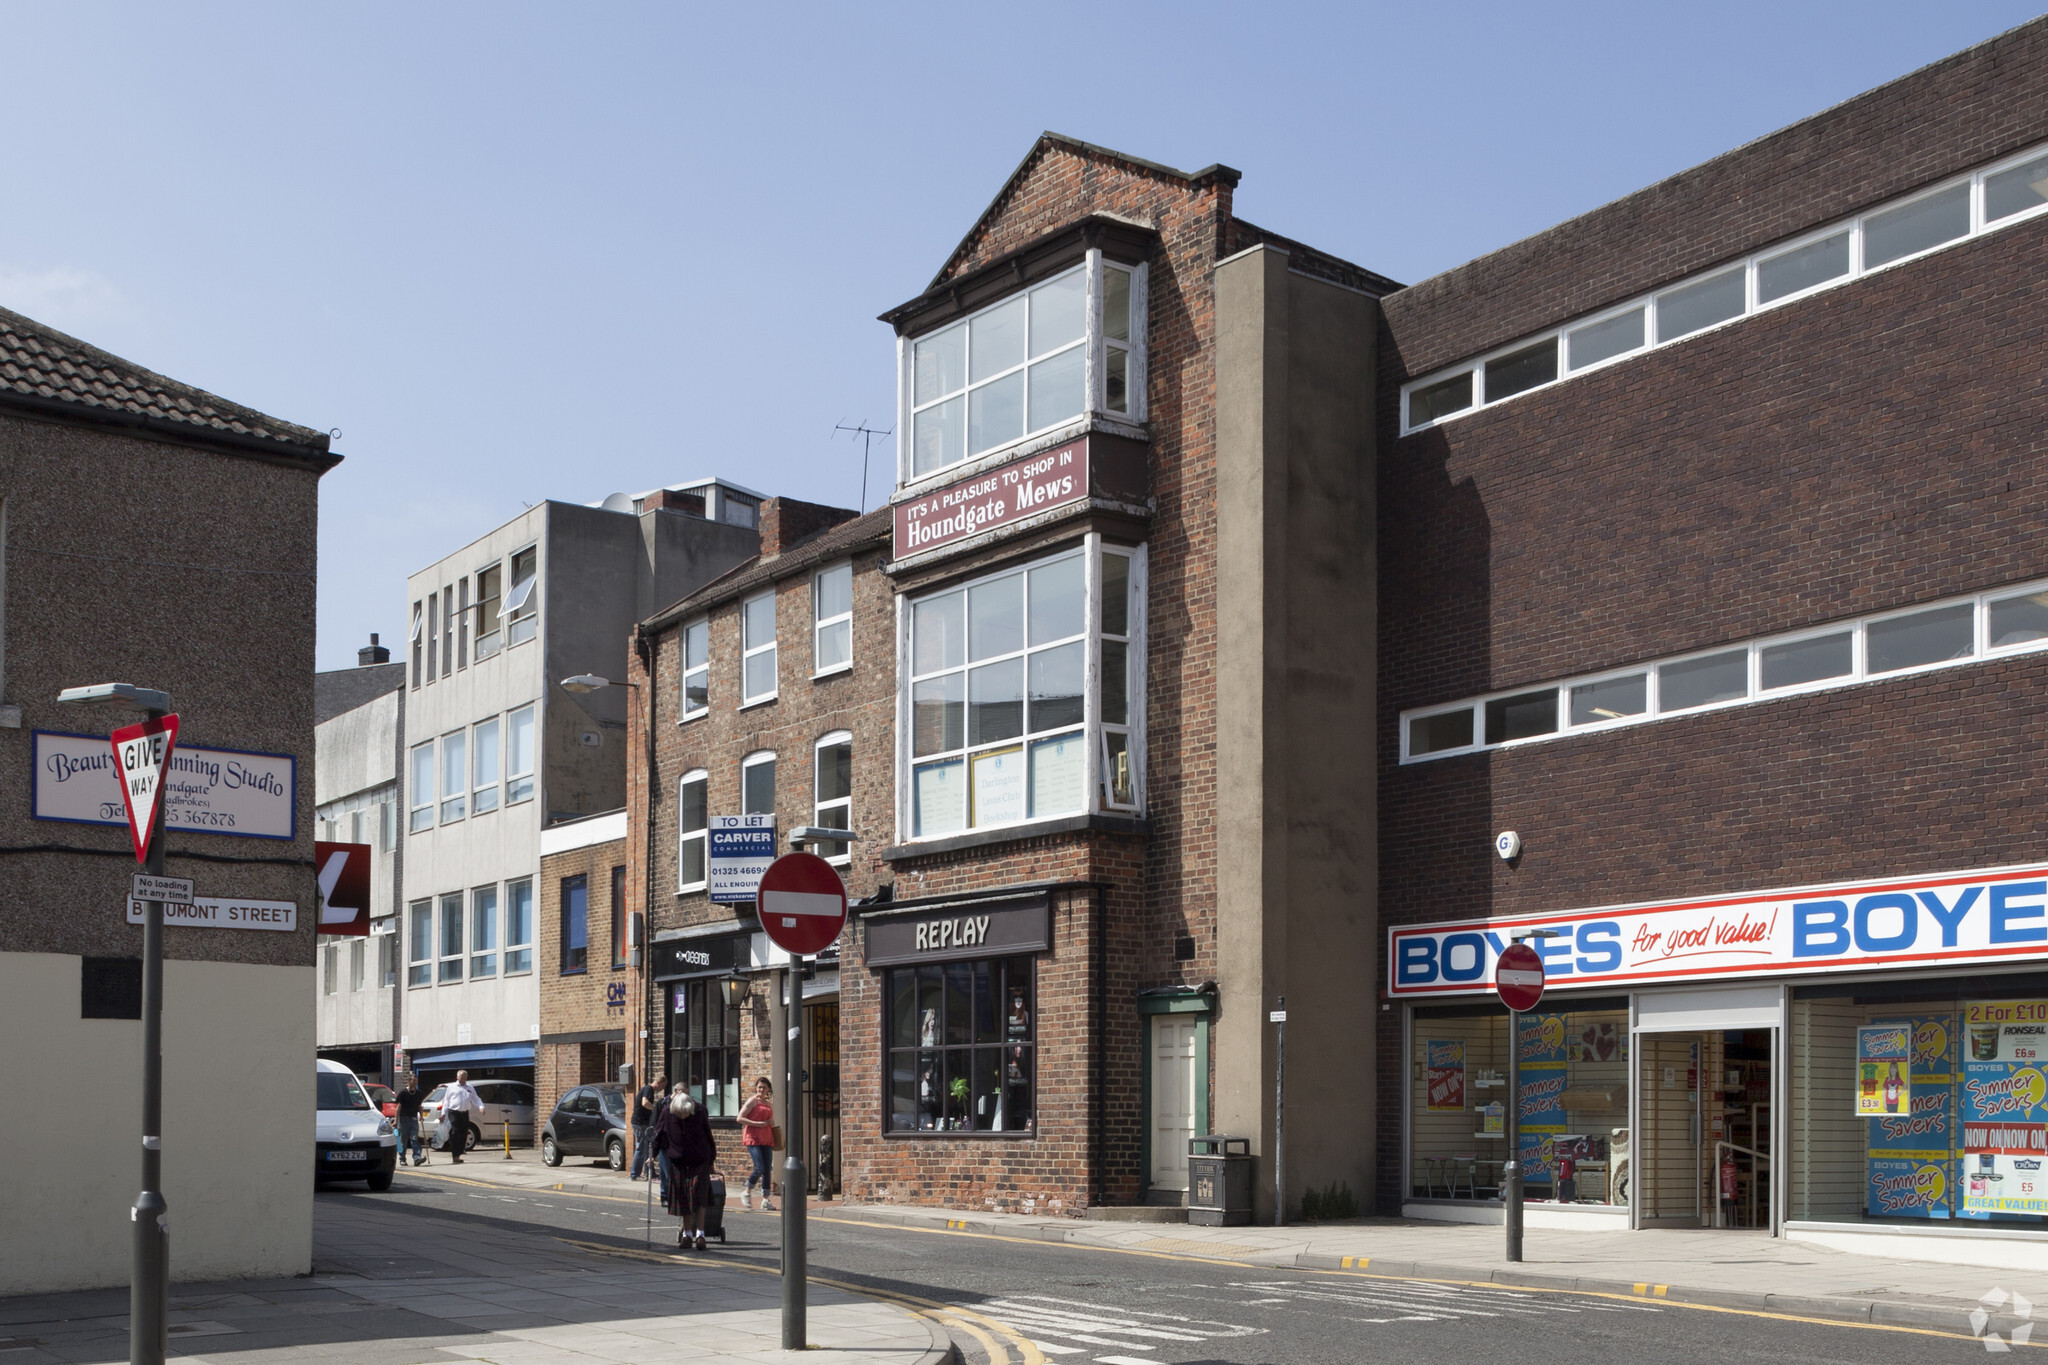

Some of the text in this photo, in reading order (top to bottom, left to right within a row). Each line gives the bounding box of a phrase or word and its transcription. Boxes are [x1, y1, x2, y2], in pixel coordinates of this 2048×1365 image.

[908, 450, 1073, 521] IT'S A PLEASURE TO SHOP IN
[907, 475, 1073, 548] Houndgate Mews
[125, 737, 162, 771] GIVE
[167, 754, 219, 787] nning
[224, 761, 284, 797] Studio
[982, 774, 1020, 789] Darlington
[131, 775, 154, 797] WAY
[1002, 791, 1021, 803] Club
[184, 811, 236, 827] 367878
[721, 816, 764, 827] TO LET
[714, 832, 771, 844] CARVER
[712, 867, 738, 876] 01325
[139, 878, 188, 891] No loading
[138, 888, 189, 900] at any time
[132, 902, 292, 923] BUMONT STREET
[916, 915, 989, 950] REPLAY
[1632, 907, 1778, 957] for good value!
[1970, 1004, 2047, 1021] 2 For £10
[1520, 1022, 1558, 1041] ummer
[1863, 1029, 1902, 1047] Summer
[2004, 1026, 2046, 1035] RONSEAL
[1867, 1040, 1901, 1057] Savers
[2015, 1048, 2036, 1058] £6.99
[1968, 1064, 2004, 1072] BOYES
[1966, 1073, 2036, 1101] Summer
[1974, 1093, 2033, 1119] Savers
[1881, 1113, 1945, 1140] Savers
[1965, 1128, 2002, 1148] NOW ON
[2003, 1129, 2046, 1149] NOW ON
[1874, 1161, 1908, 1170] BOYES
[1872, 1171, 1939, 1194] Summer
[2021, 1182, 2034, 1192] £5
[1878, 1189, 1935, 1212] Savers
[1967, 1197, 2048, 1211] GREAT VALUE!
